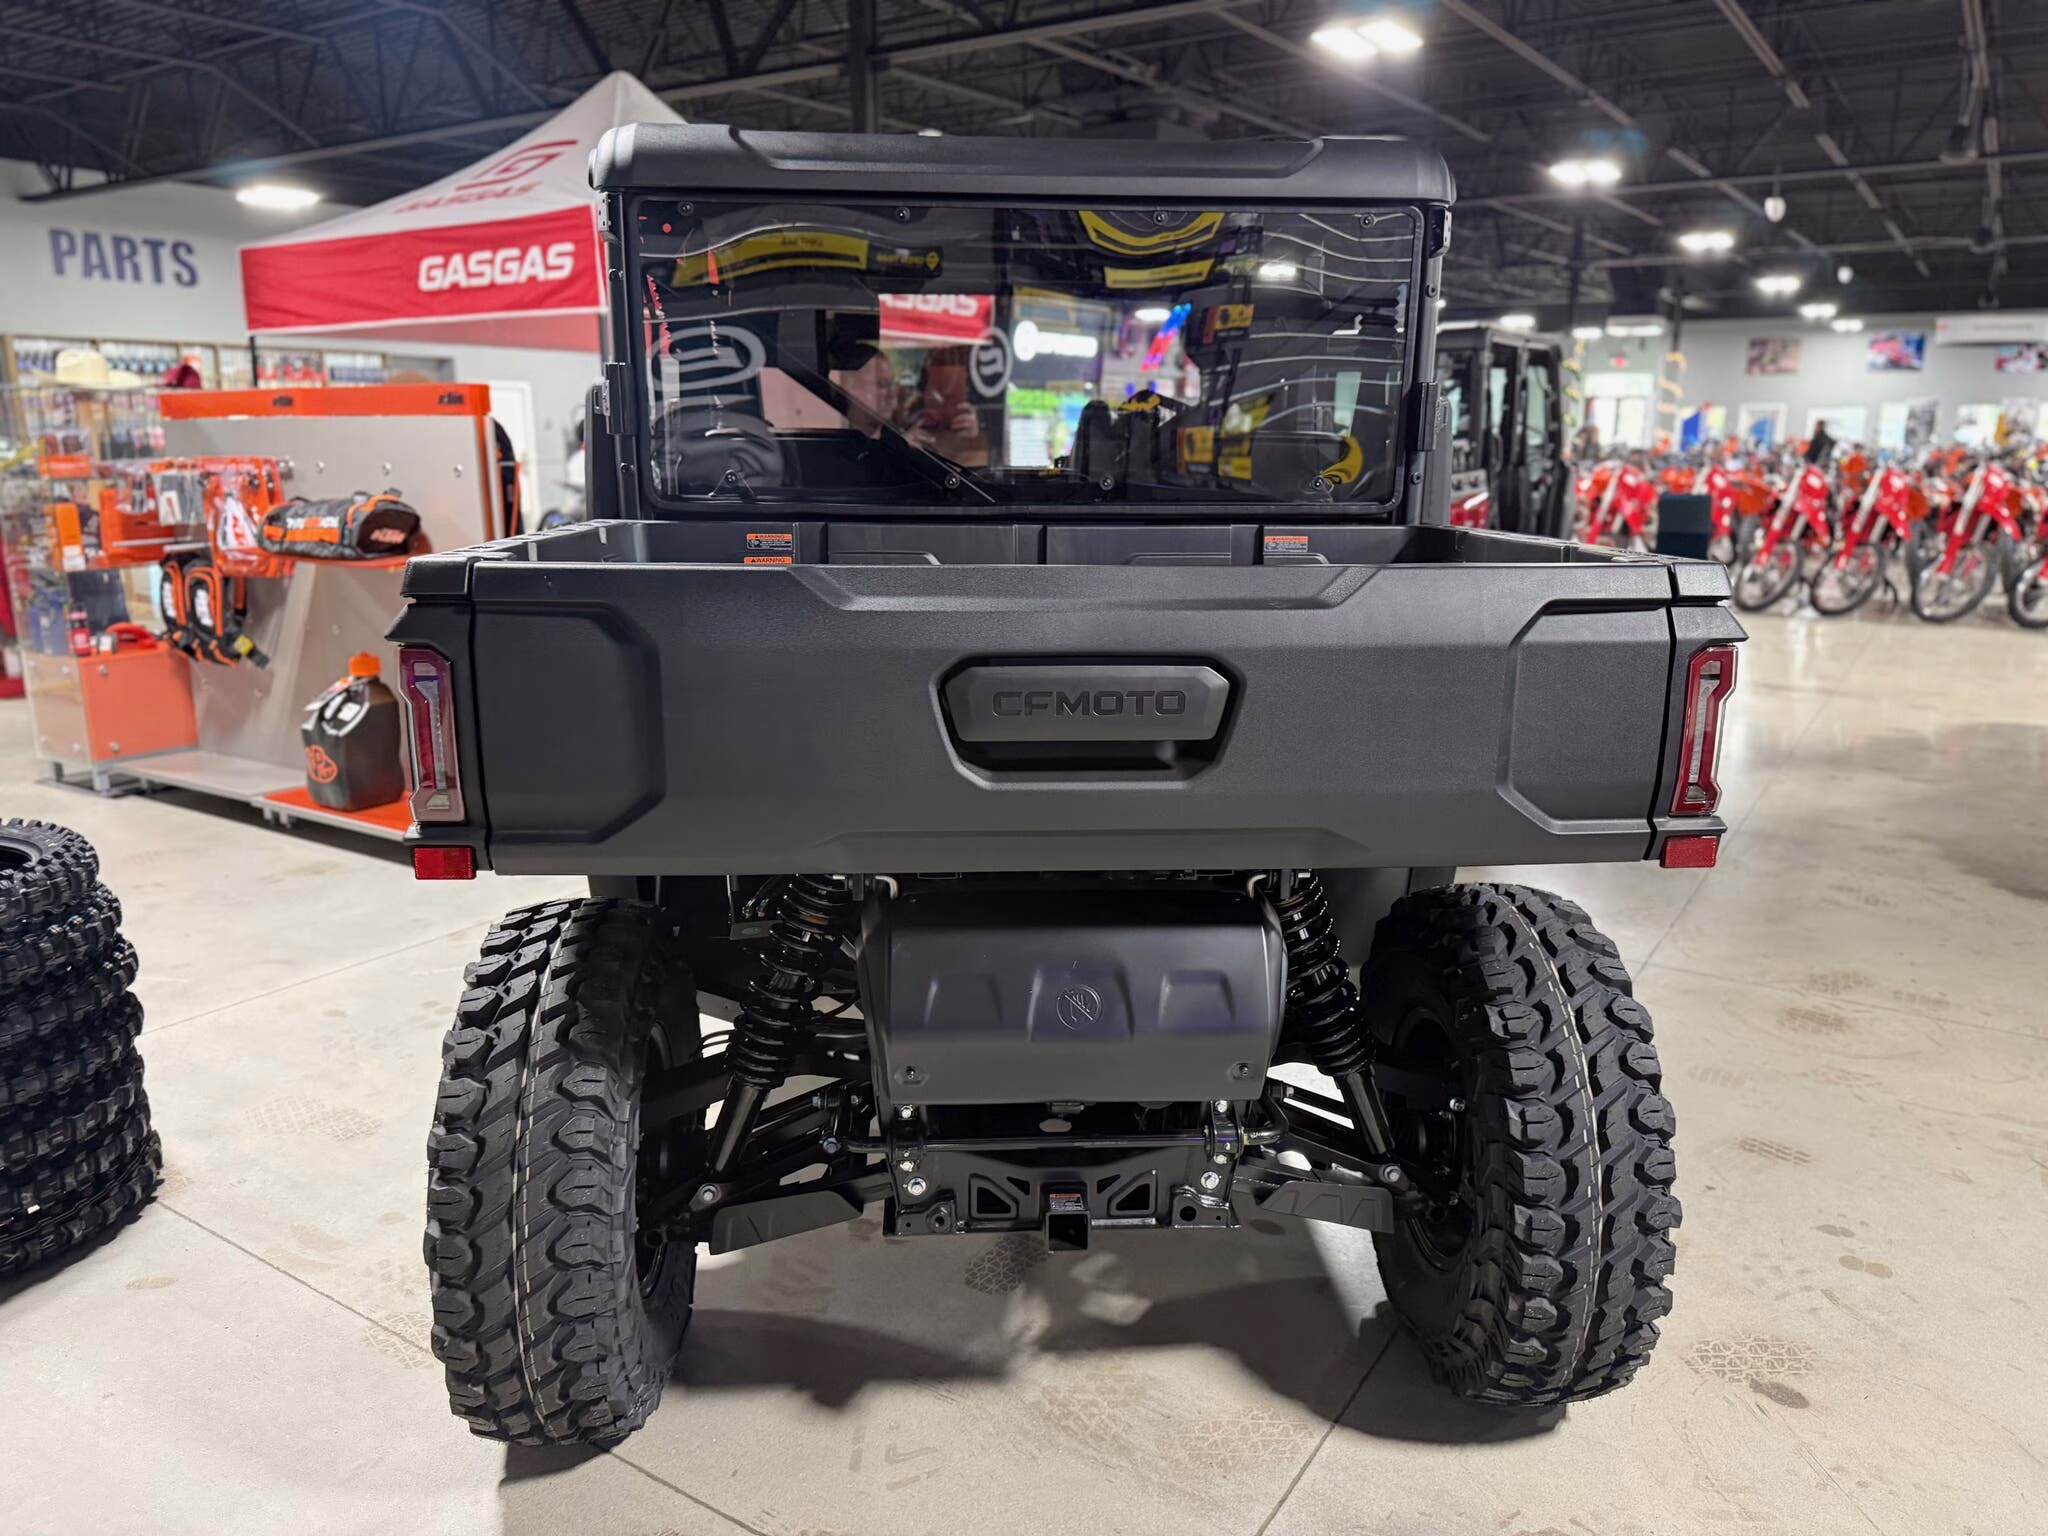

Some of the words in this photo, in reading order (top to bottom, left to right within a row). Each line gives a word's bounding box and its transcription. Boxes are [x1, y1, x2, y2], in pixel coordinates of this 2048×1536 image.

[49, 229, 198, 287] PARTS
[418, 242, 576, 292] GASGAS
[992, 690, 1186, 716] CFMOTO
